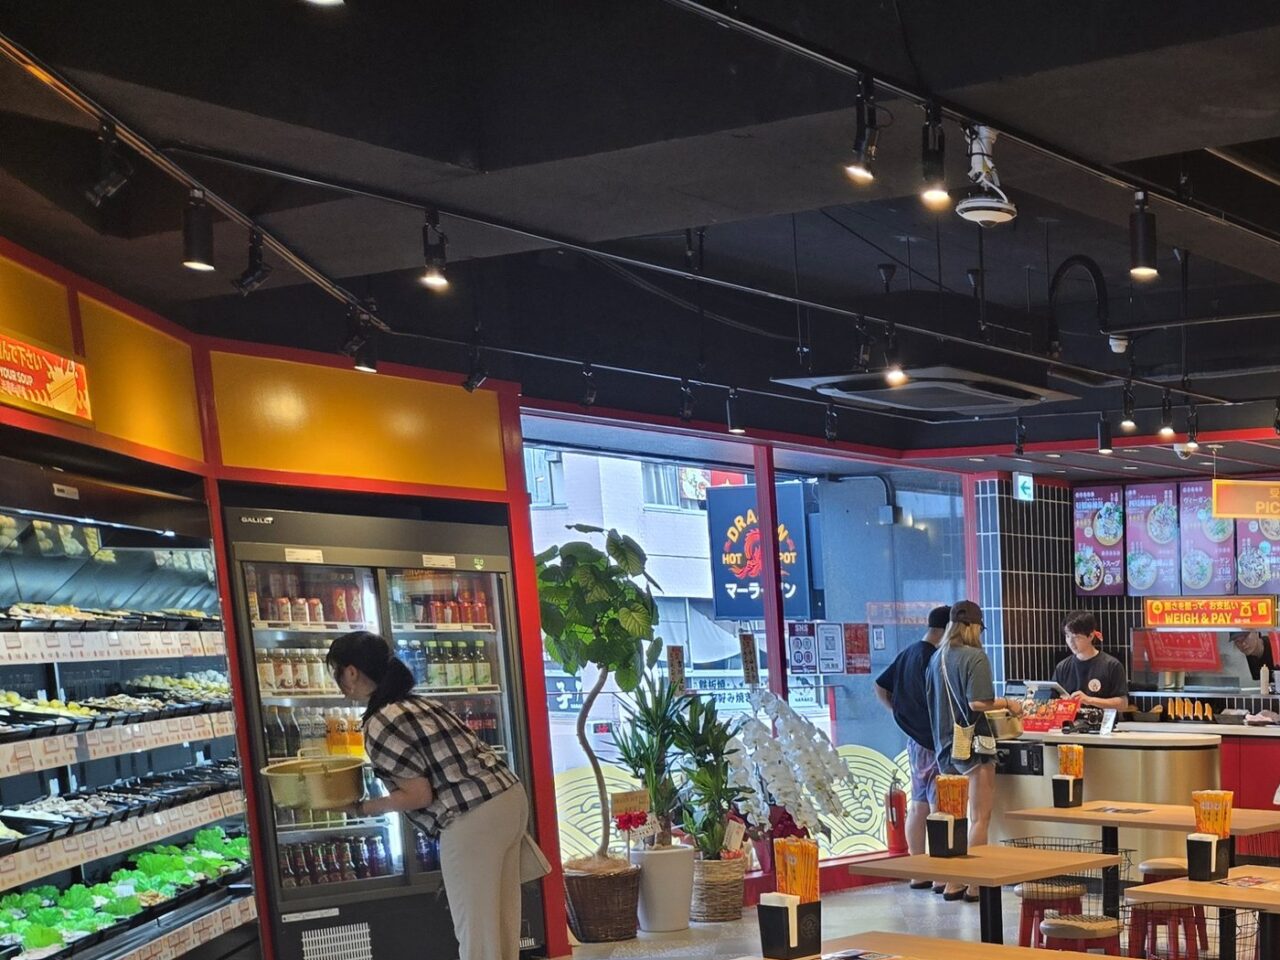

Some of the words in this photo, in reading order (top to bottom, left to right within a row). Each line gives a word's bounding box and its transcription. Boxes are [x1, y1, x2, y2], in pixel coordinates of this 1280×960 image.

[726, 508, 789, 543] DRAN
[722, 553, 742, 565] HOT
[725, 582, 797, 600] マーラン
[1164, 612, 1200, 625] WEIGH
[1201, 612, 1209, 624] &
[1211, 612, 1233, 624] PAY
[795, 624, 809, 633] SNS
